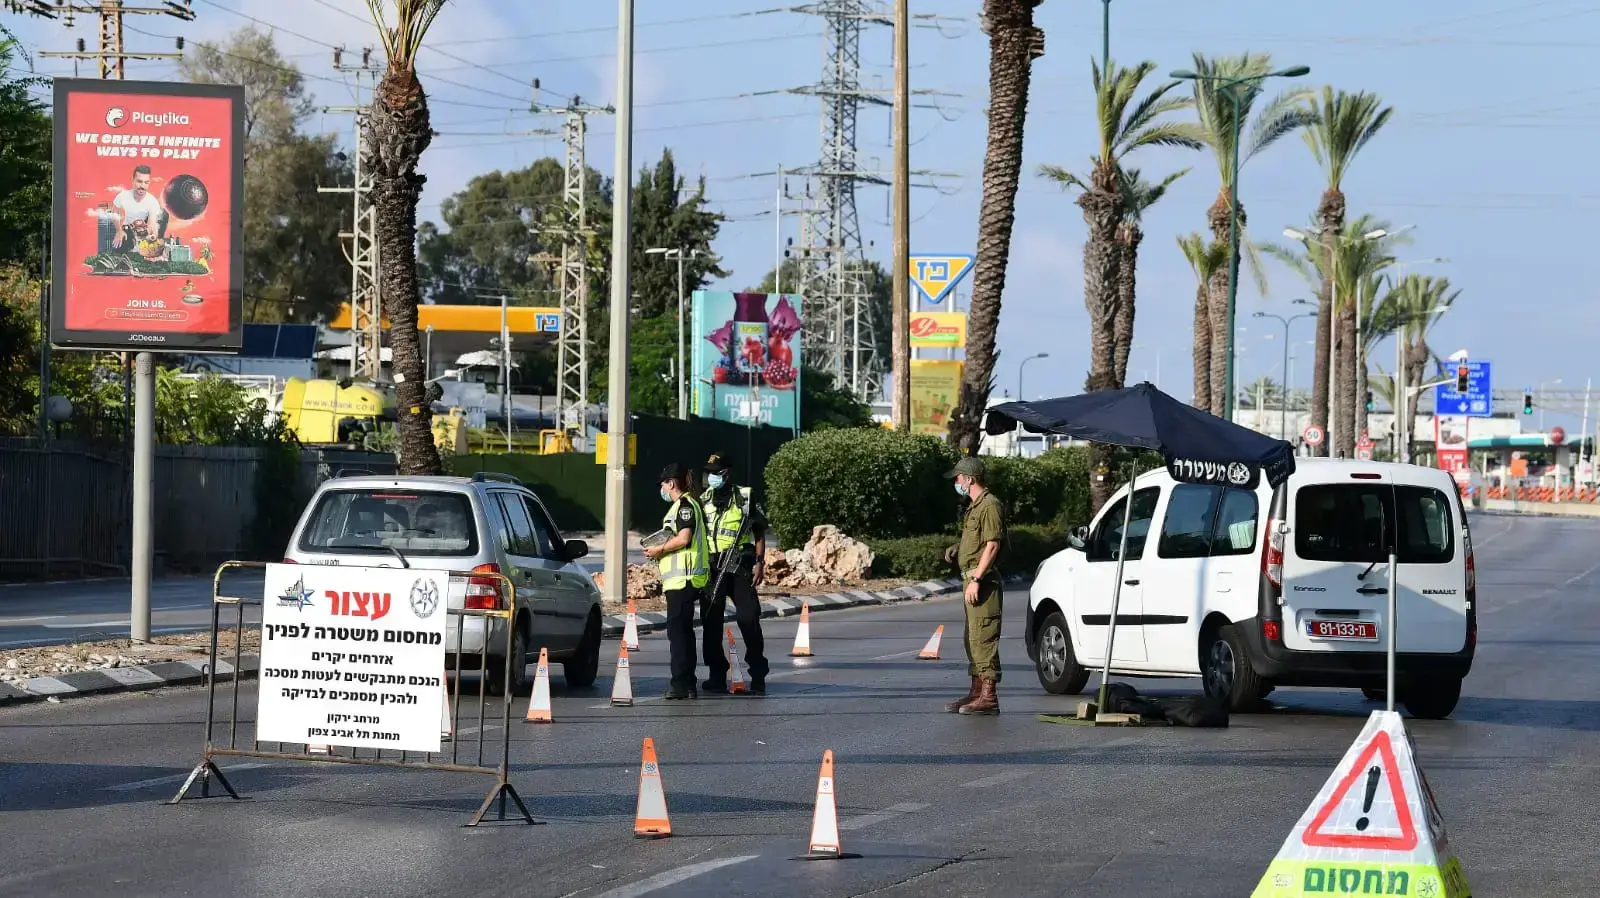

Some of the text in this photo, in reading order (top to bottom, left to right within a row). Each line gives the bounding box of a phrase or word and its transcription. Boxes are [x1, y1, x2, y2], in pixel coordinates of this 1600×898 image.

[132, 111, 189, 127] Playtika
[75, 132, 221, 149] WE CREATE INFINITE
[96, 146, 200, 160] WAYS TO PLAY
[916, 261, 949, 281] פז
[126, 299, 167, 309] JOIN US.
[535, 313, 560, 331] פז
[128, 333, 166, 342] JCDecaux
[1307, 431, 1319, 440] 50
[1173, 458, 1227, 481] משטרה
[325, 591, 391, 621] עצור
[265, 622, 442, 645] מחסום משטרה לפניך
[311, 651, 394, 665] אזרחים יקרים
[265, 668, 440, 687] הנכם מתבקשים לעטות מסכה
[281, 687, 418, 706] ולהכין מסמכים לבדיקה
[327, 713, 380, 724] מרחב ירקון
[307, 727, 400, 741] תחנת תל אביב צפון
[1303, 867, 1409, 895] מחסום
